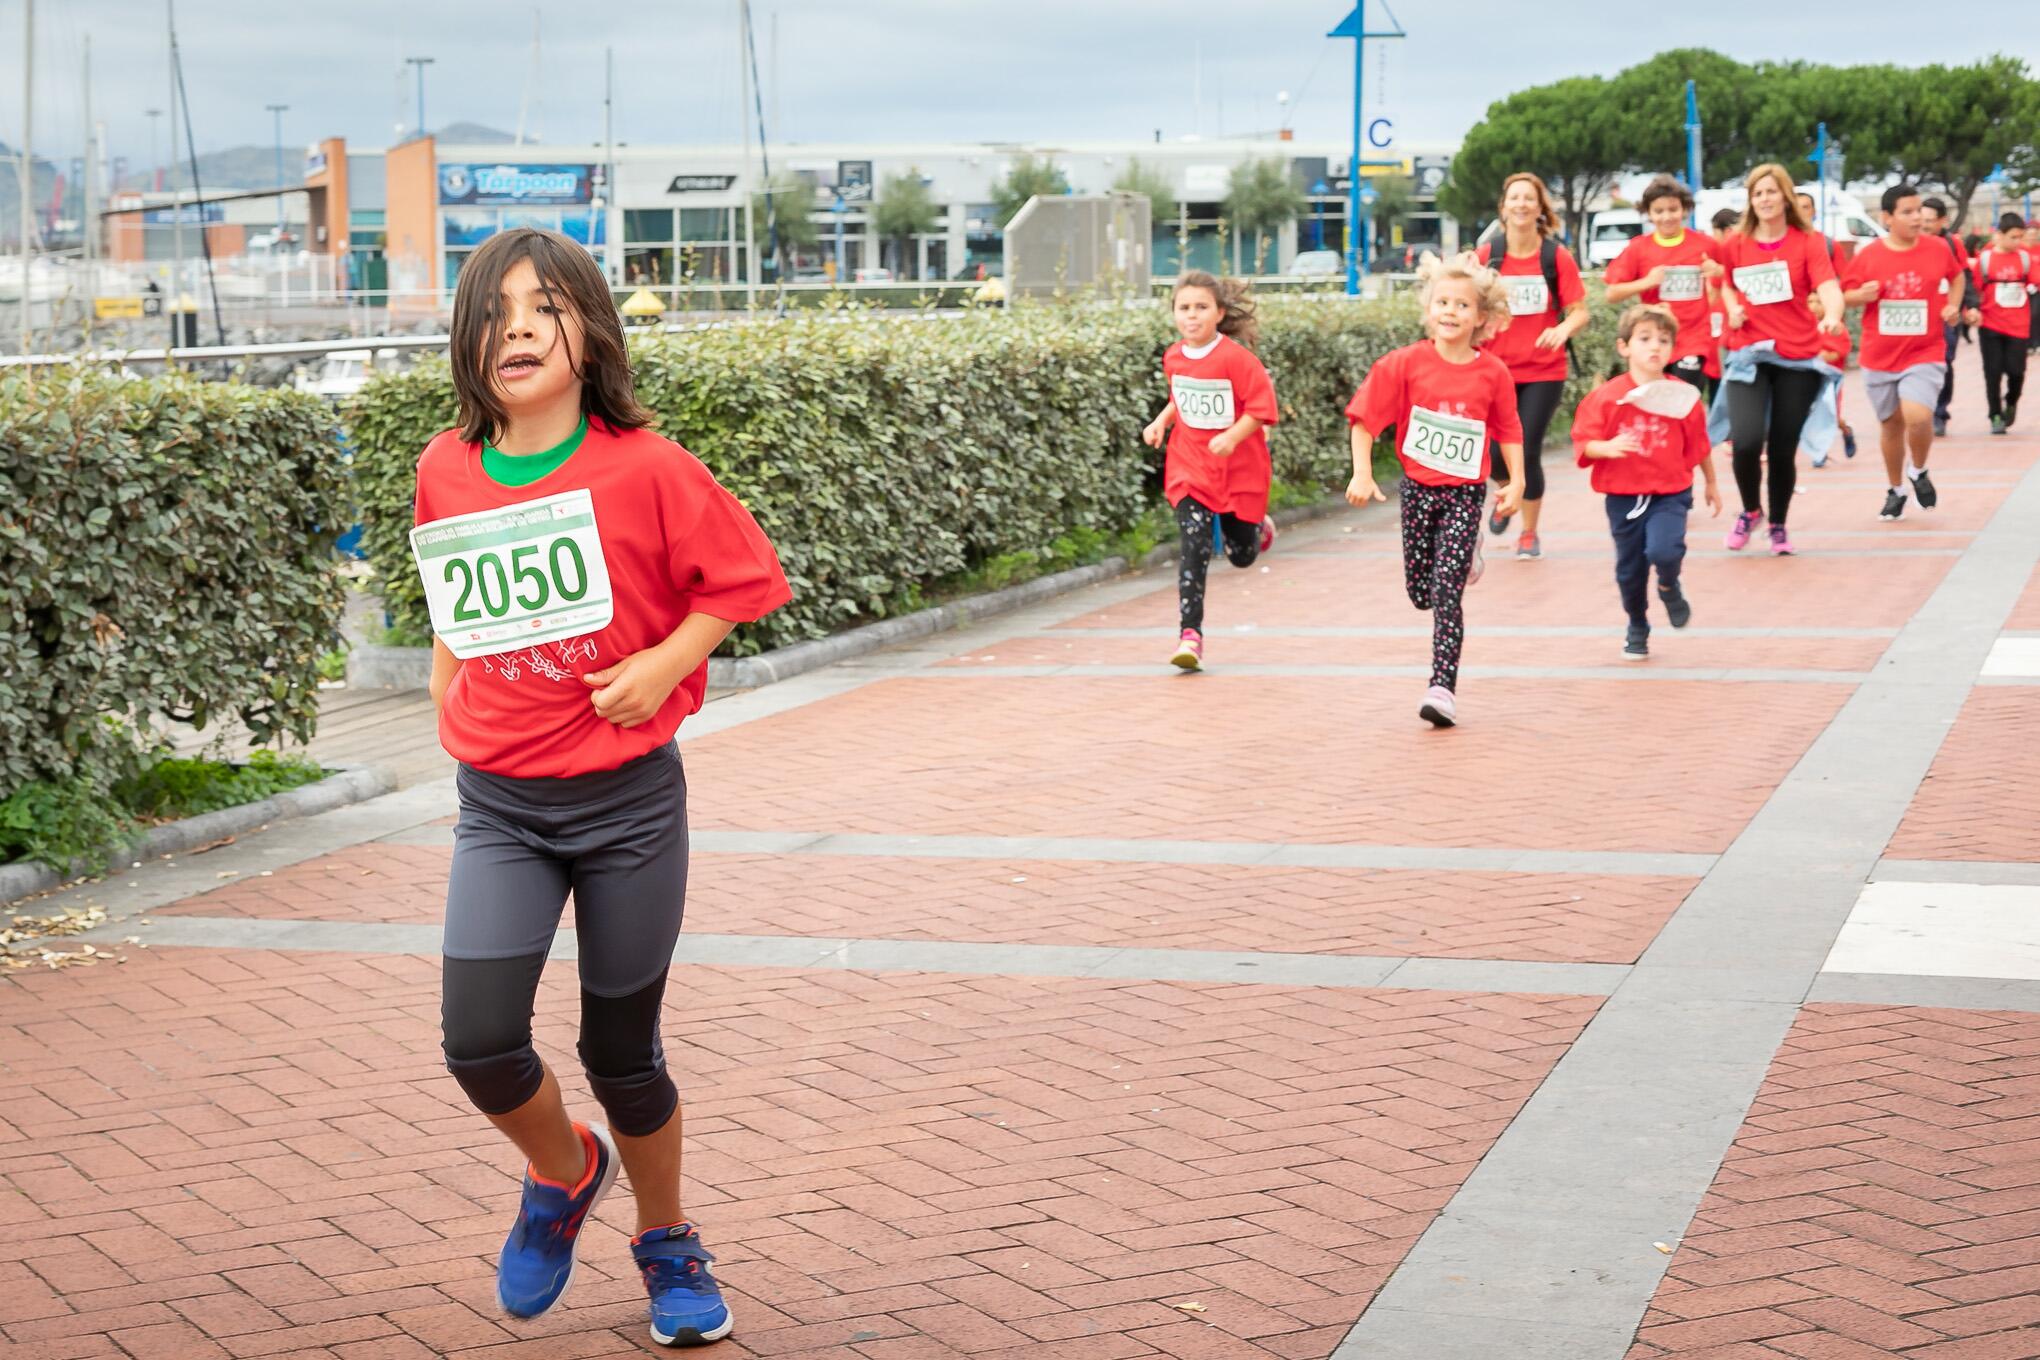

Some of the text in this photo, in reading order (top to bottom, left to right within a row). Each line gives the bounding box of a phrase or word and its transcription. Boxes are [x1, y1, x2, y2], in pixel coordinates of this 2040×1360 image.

[1369, 119, 1392, 147] C
[476, 168, 577, 197] Tarpoon
[1742, 274, 1784, 296] 2050
[1885, 308, 1922, 327] 2023
[1179, 391, 1225, 416] 2050
[1414, 426, 1475, 463] 2050
[444, 537, 588, 623] 2050
